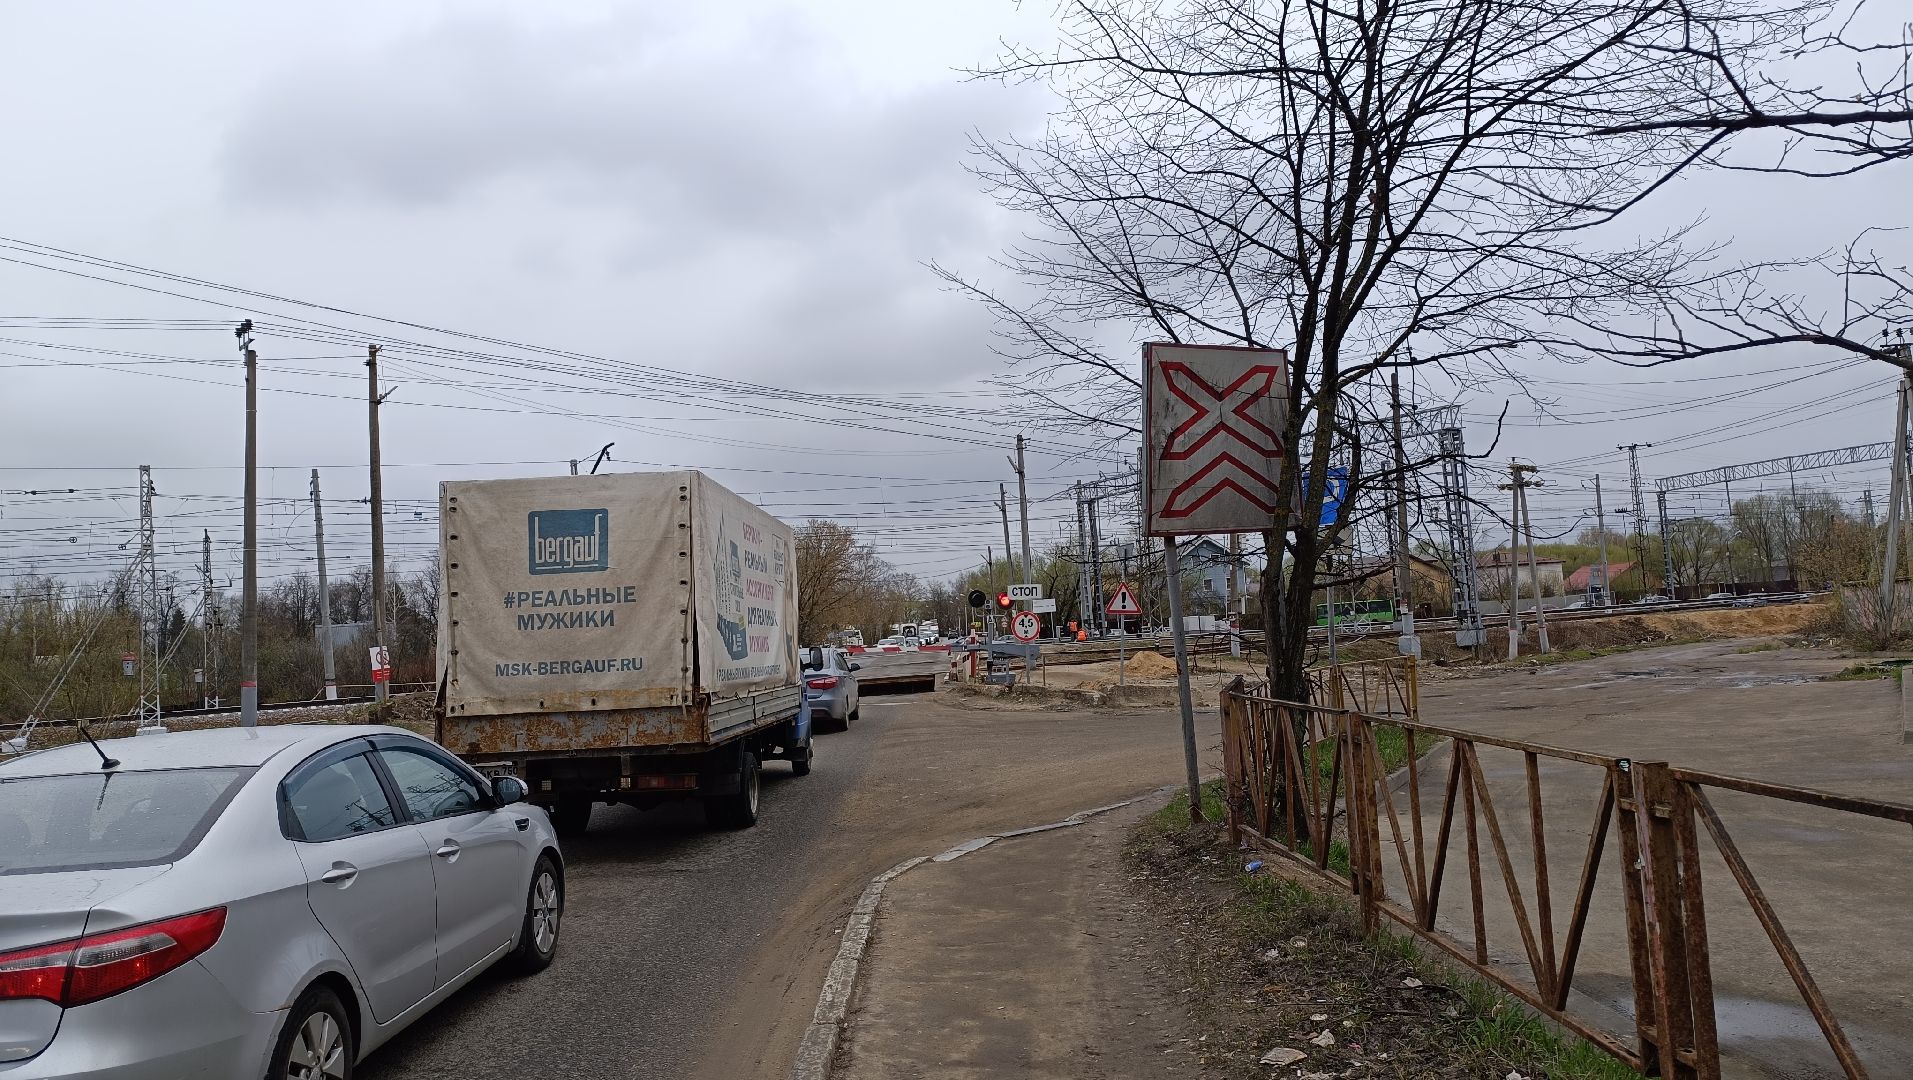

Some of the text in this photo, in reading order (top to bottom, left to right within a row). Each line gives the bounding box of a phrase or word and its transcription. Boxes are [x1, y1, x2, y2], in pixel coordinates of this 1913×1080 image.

[534, 513, 603, 569] bergauf
[503, 585, 637, 609] #РЕАЛЬНЫЕ
[1011, 586, 1038, 597] СТОП
[517, 610, 615, 631] МУЖИКИ
[1018, 618, 1033, 628] 4,5
[495, 657, 643, 677] MSK-BERGAUF.RU
[502, 766, 518, 775] 750
